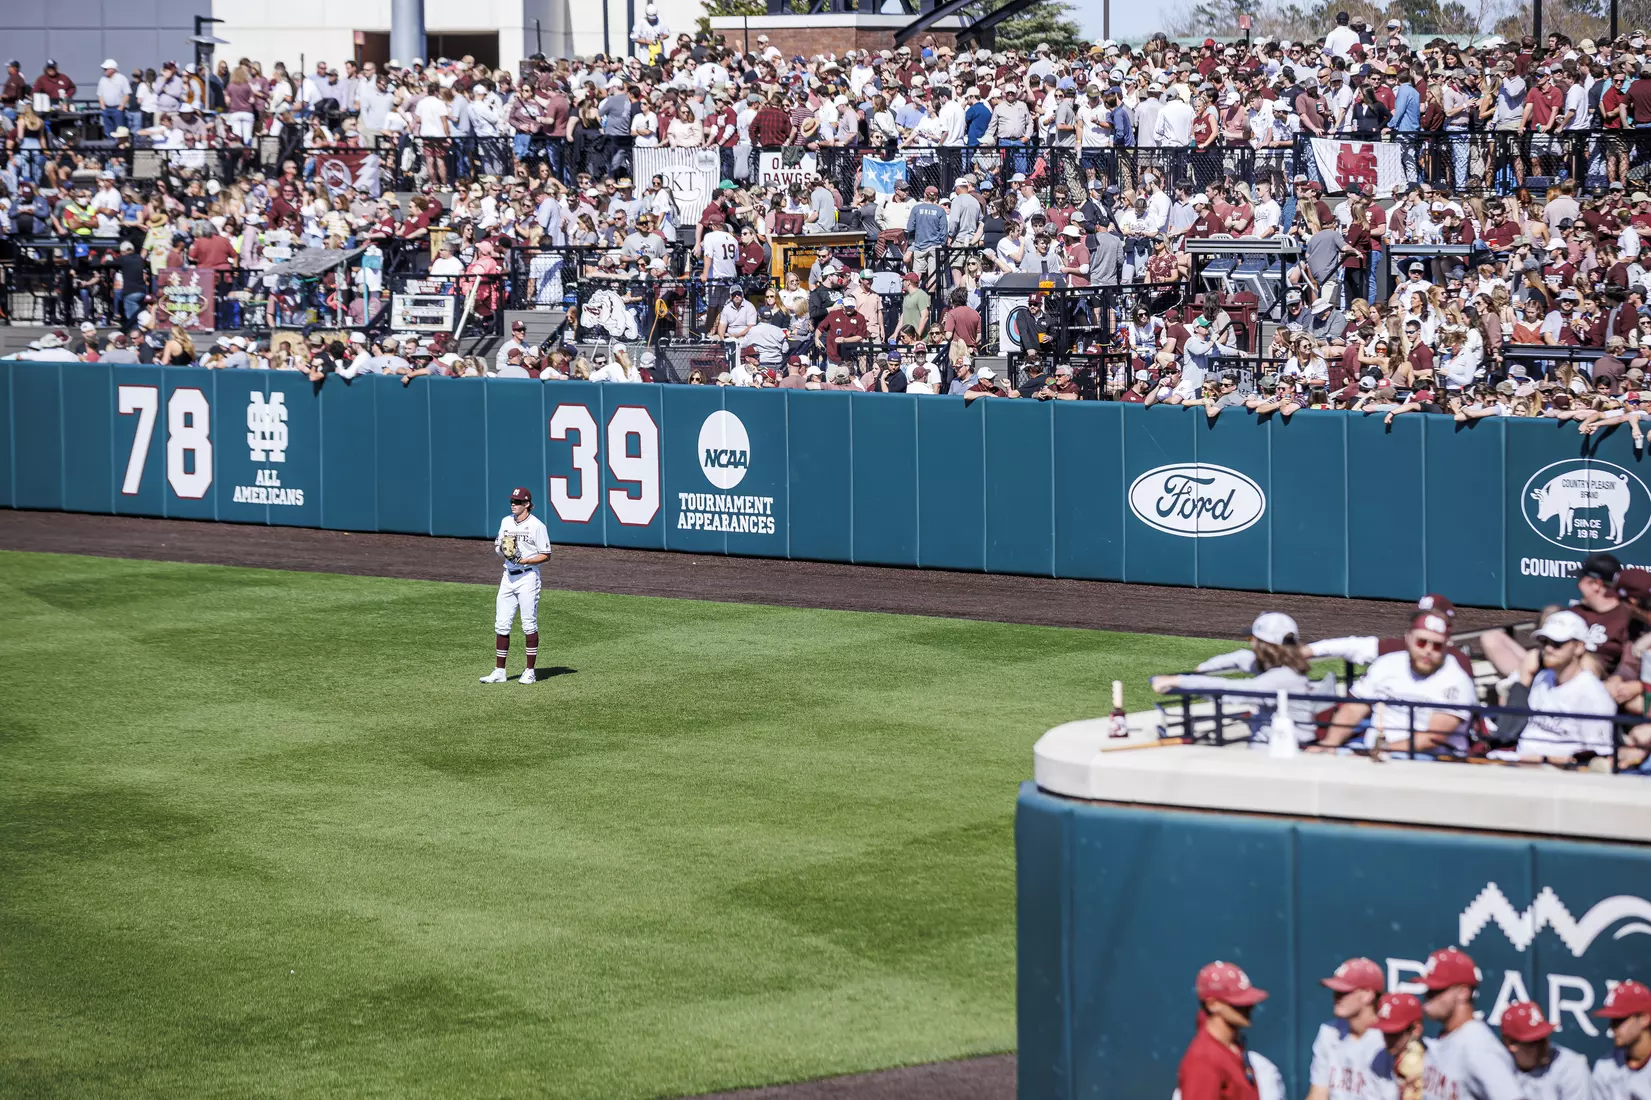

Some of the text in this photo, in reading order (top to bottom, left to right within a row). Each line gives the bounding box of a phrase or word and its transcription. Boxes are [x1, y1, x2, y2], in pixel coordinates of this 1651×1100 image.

[772, 157, 802, 169] OA
[764, 173, 811, 185] DAWGS
[722, 244, 735, 260] 19
[118, 385, 213, 500] 78
[549, 402, 661, 527] 39
[704, 449, 748, 469] NCAA
[255, 470, 281, 486] ALL
[233, 486, 304, 506] AMERICANS
[678, 492, 773, 514] TOURNAMENT
[1156, 474, 1236, 521] Ford
[677, 512, 775, 534] APPEARANCES
[1574, 519, 1602, 529] SINCE
